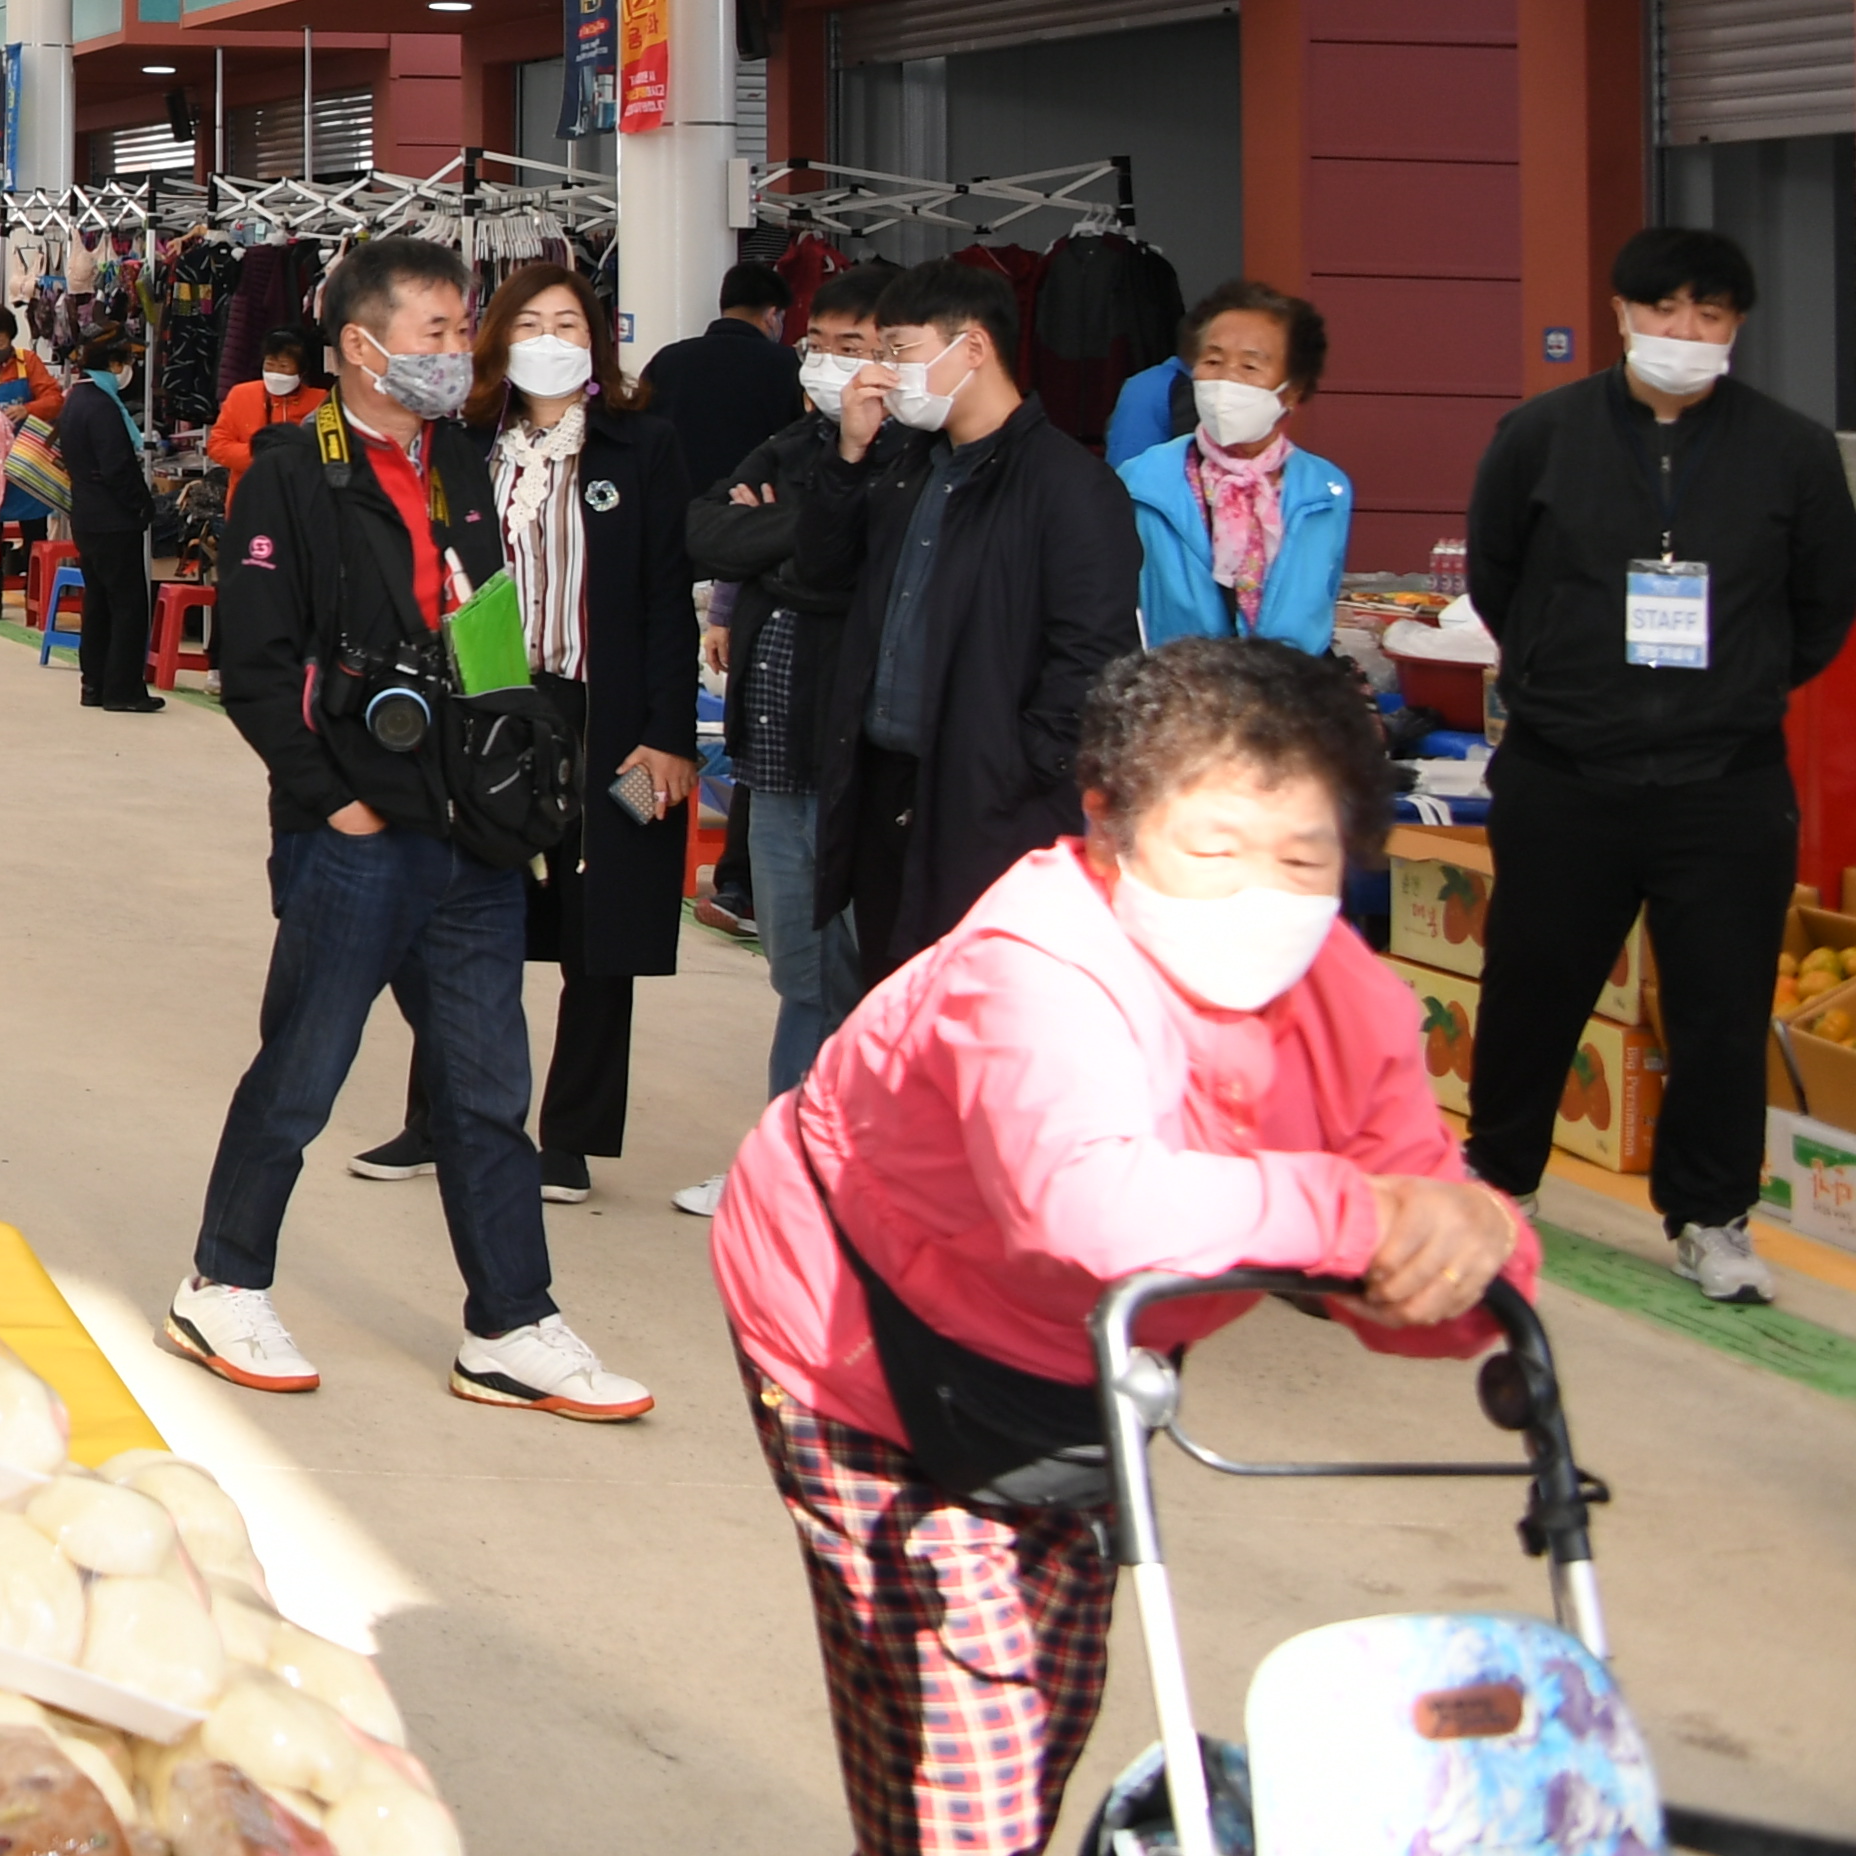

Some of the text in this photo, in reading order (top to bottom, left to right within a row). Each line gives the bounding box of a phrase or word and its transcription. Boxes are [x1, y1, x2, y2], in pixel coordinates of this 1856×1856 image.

[1633, 609, 1697, 630] STAFF
[1624, 1046, 1638, 1156] Big Persimmon
